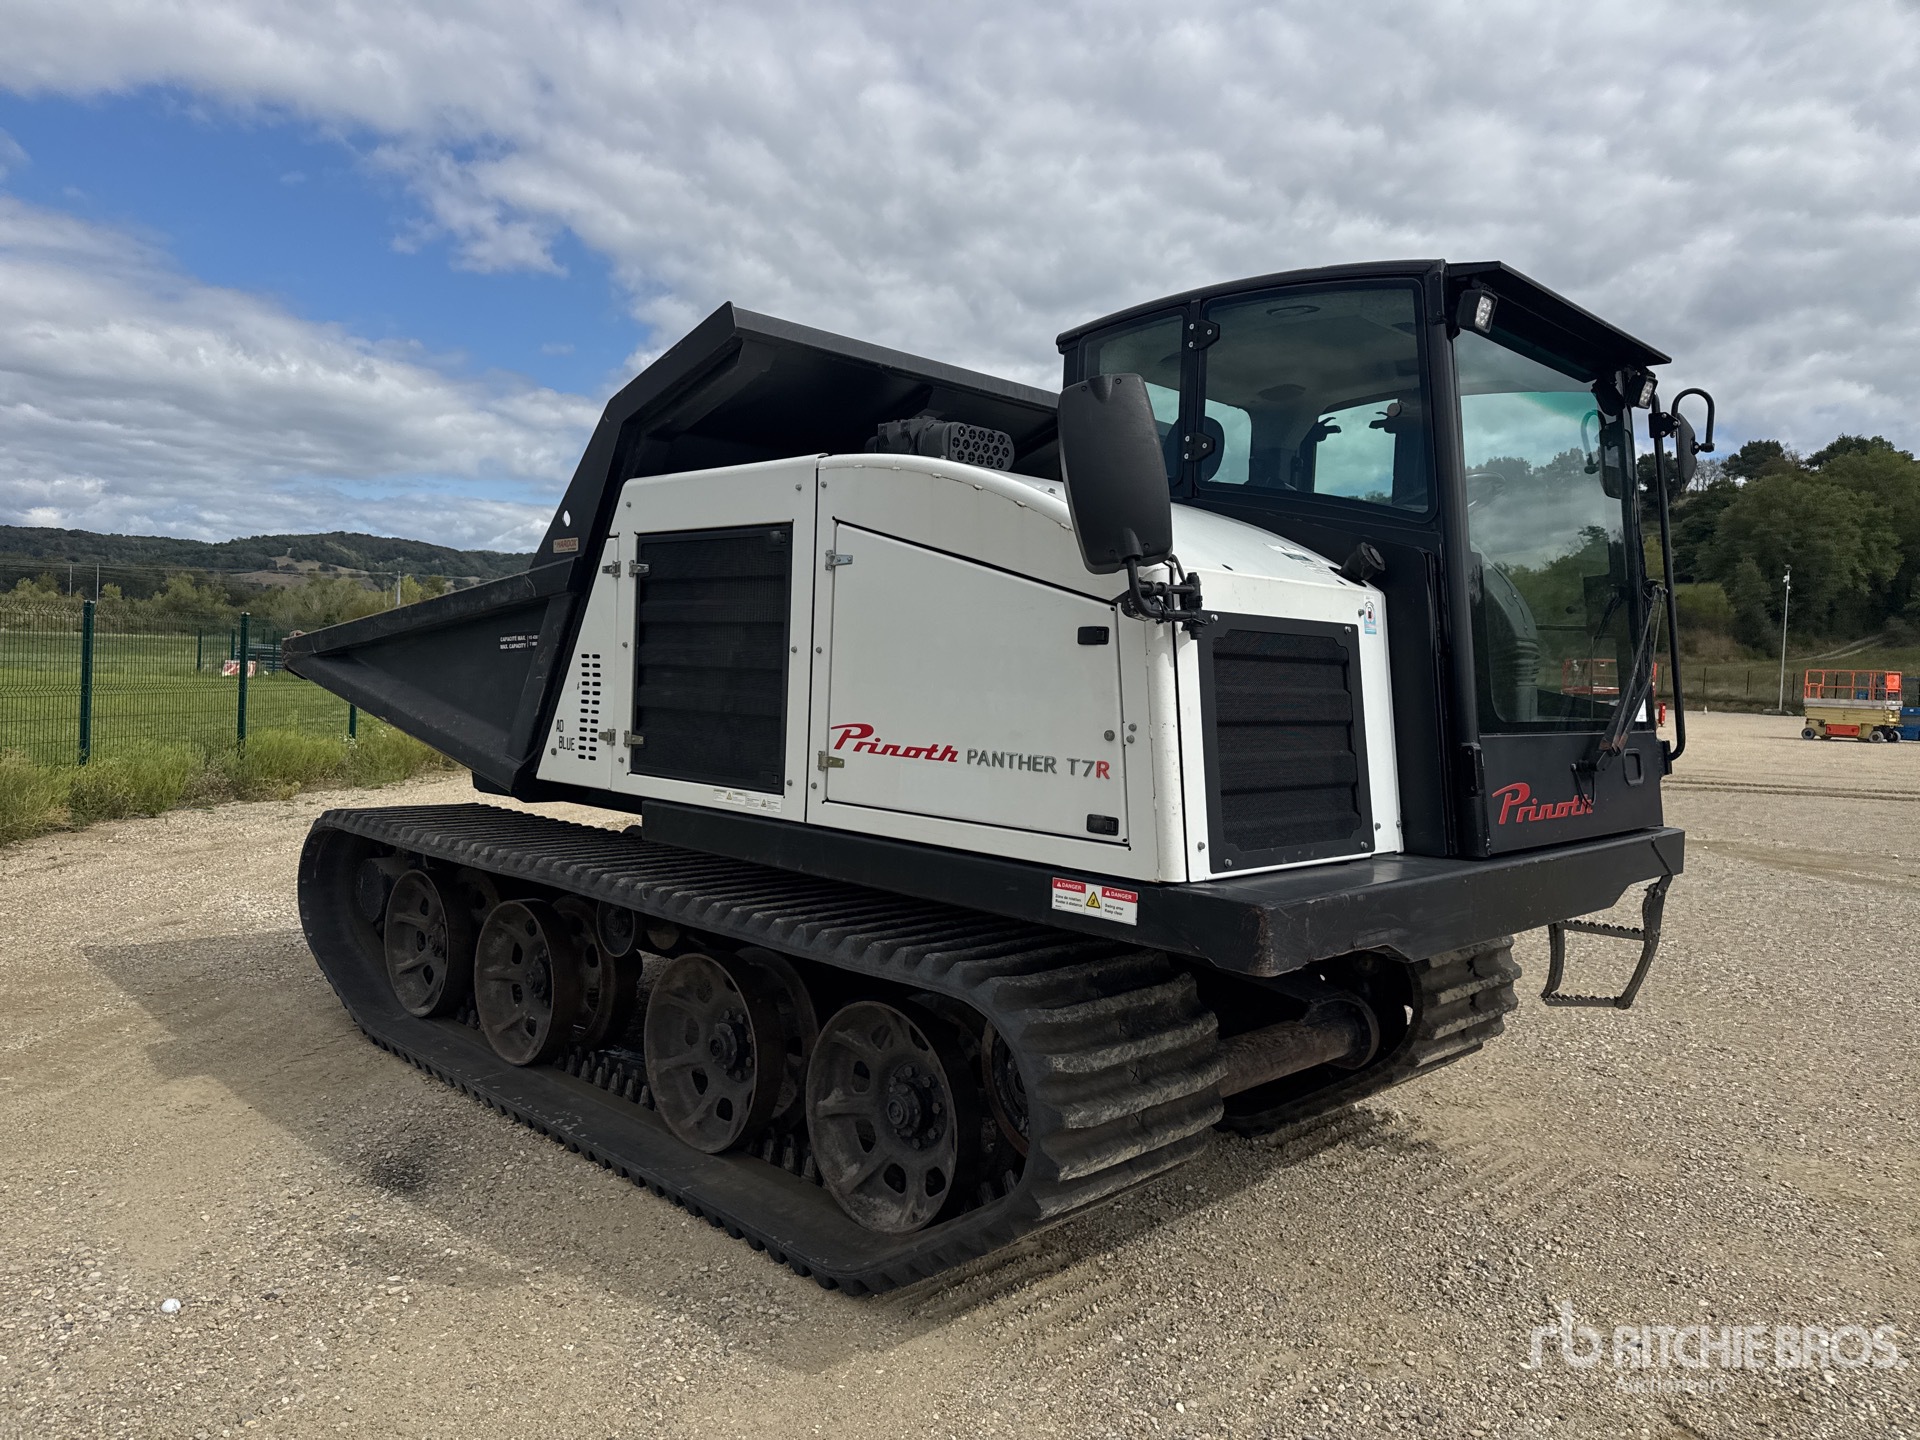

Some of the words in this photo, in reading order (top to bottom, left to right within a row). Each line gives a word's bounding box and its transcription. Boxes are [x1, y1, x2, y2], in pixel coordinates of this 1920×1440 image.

[556, 719, 564, 732] AD
[559, 736, 575, 751] BLUE
[831, 723, 959, 763] Prinoth
[966, 748, 1057, 774] PANTHER
[1066, 758, 1110, 780] T7R
[1061, 882, 1082, 890] DANGER
[1110, 891, 1132, 900] DANGER
